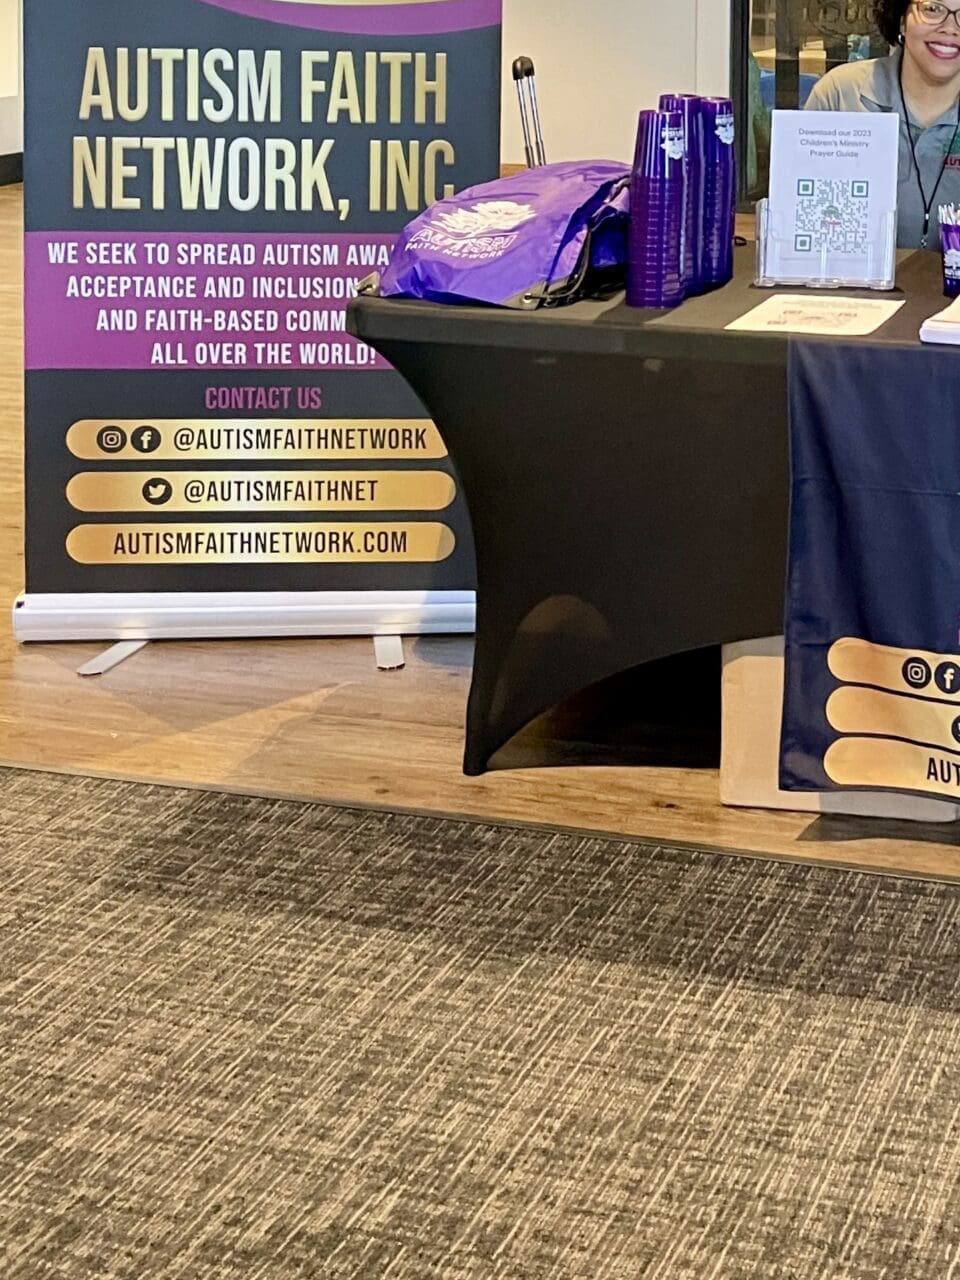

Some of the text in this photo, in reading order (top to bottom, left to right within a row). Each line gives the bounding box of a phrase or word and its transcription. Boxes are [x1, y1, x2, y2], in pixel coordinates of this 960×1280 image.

[78, 46, 448, 124] AUTISM FAITH
[798, 127, 837, 137] Download
[800, 139, 870, 148] Children's Ministry
[809, 149, 834, 158] Prayer
[72, 136, 350, 221] NETWORK,
[47, 242, 394, 266] WE SEEK TO SPREAD AUTISM AWA
[404, 242, 505, 259] FAITH NETWORK
[66, 275, 198, 298] ACCEPTANCE
[203, 276, 246, 298] AND
[96, 309, 138, 331] AND
[144, 309, 279, 332] FAITH-BASED
[150, 342, 377, 365] ALL OVER THE WORLD!
[205, 386, 323, 410] CONTACT US
[173, 427, 428, 453] @AUTISMFAITHNETWORK
[183, 479, 379, 504] @AUTISMFAITHNET
[113, 531, 408, 555] AUTISMFAITHNETWORK.COM
